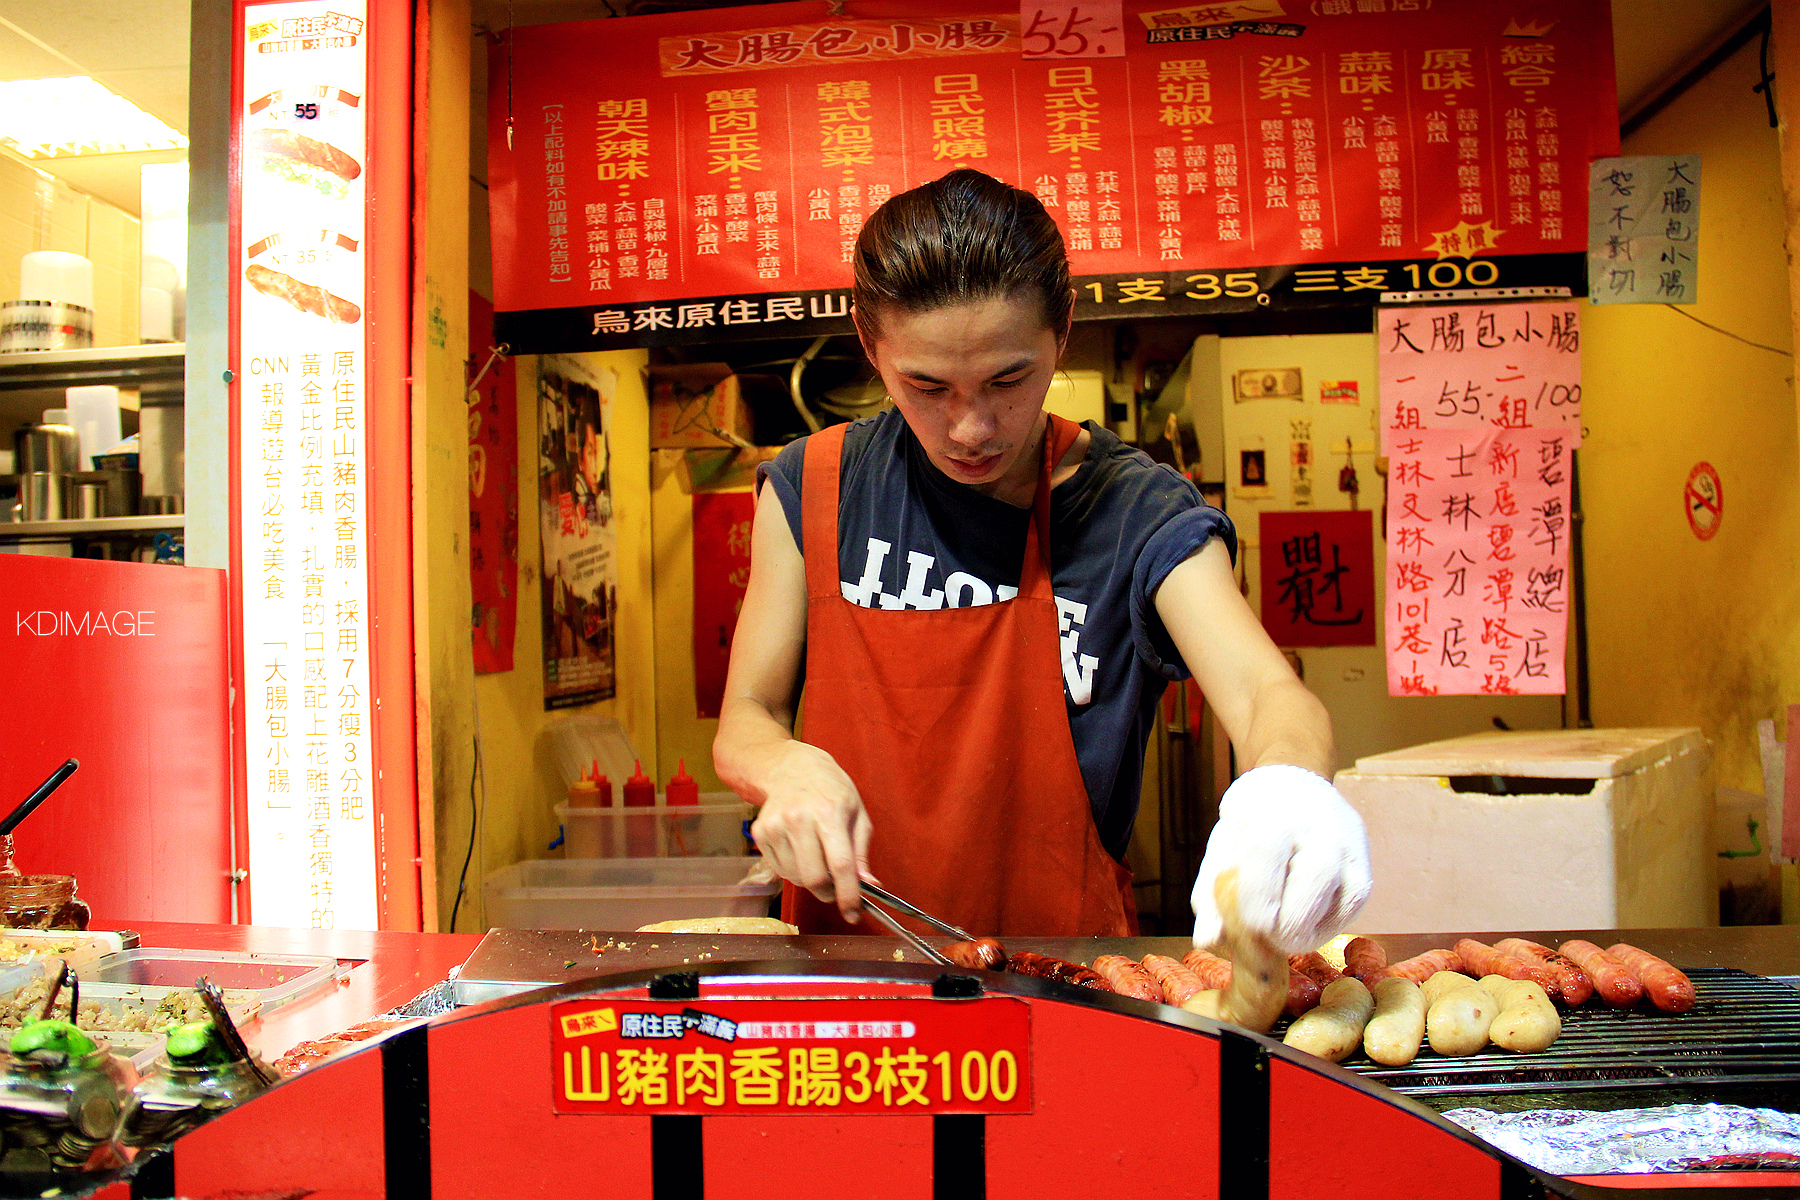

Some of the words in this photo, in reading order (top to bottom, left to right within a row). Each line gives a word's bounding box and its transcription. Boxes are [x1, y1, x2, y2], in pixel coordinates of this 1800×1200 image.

[673, 20, 1009, 71] 大腸包小腸
[295, 103, 317, 120] 55
[1425, 111, 1450, 143] 小黃瓜
[1342, 116, 1367, 149] 小黃瓜
[808, 188, 832, 221] 小黃瓜
[1035, 175, 1059, 207] 小黃瓜
[1657, 161, 1694, 298] 大腸包小腸
[1402, 260, 1499, 289] 100
[1390, 310, 1580, 353] 大腸包小腸
[1441, 444, 1482, 669] 士林分店
[1514, 437, 1564, 678] 碧潭總店
[563, 1045, 1018, 1107] 山豬肉香腸3枝100
